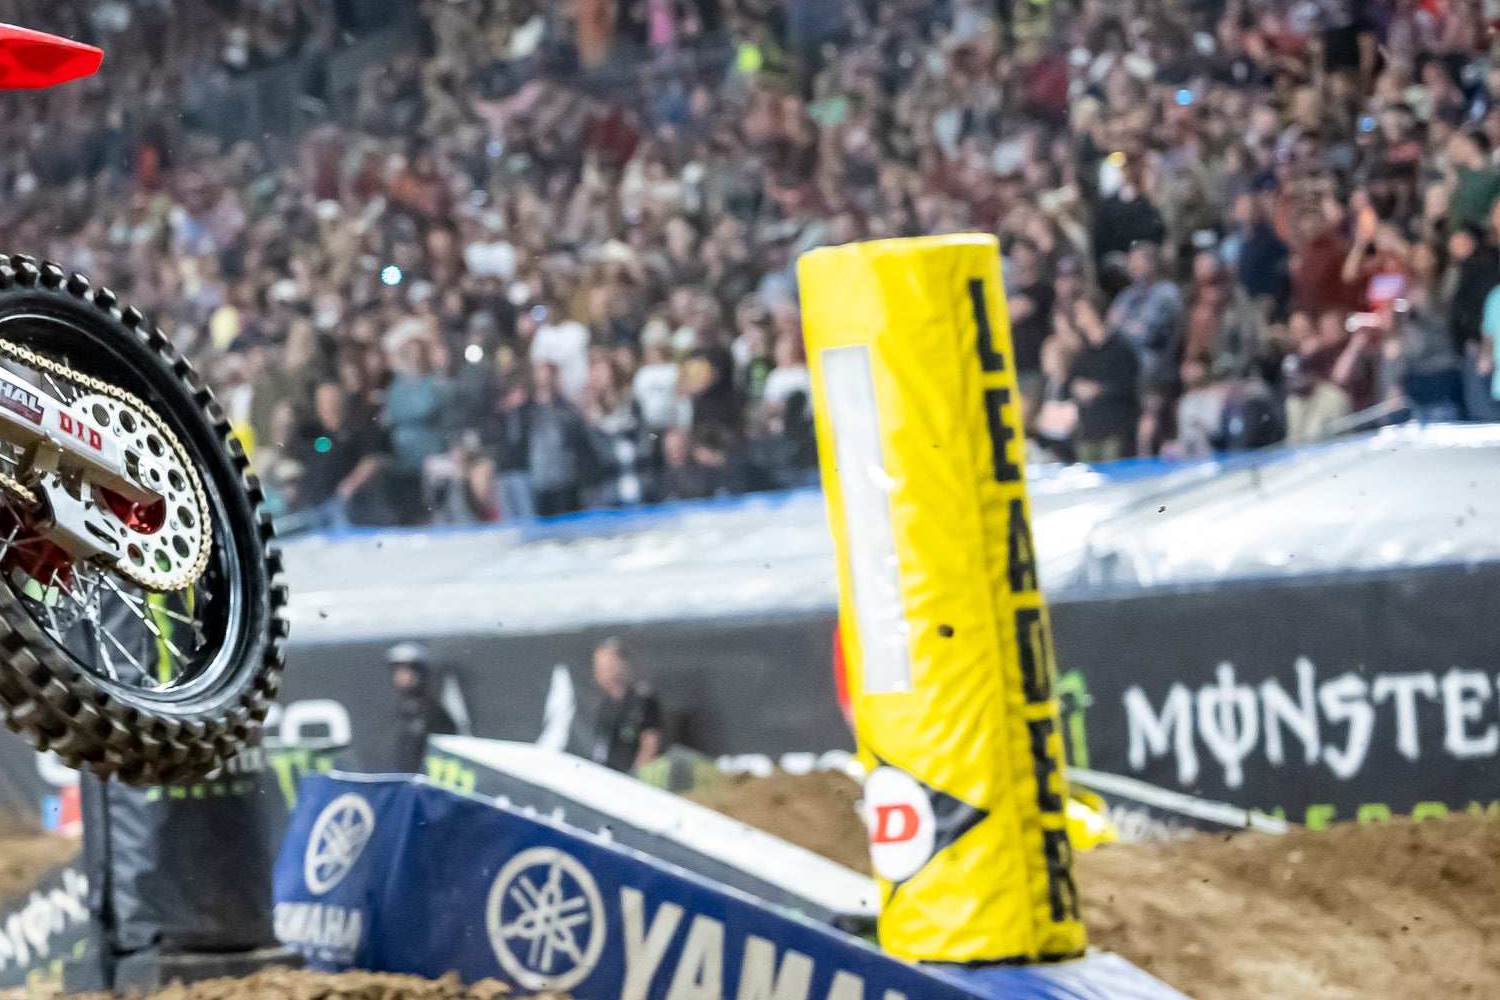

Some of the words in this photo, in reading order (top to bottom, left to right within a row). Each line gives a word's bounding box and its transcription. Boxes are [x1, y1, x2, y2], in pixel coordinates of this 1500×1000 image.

[58, 410, 103, 451] DID
[968, 278, 1081, 922] LEADER
[1122, 656, 1500, 790] MONSTE
